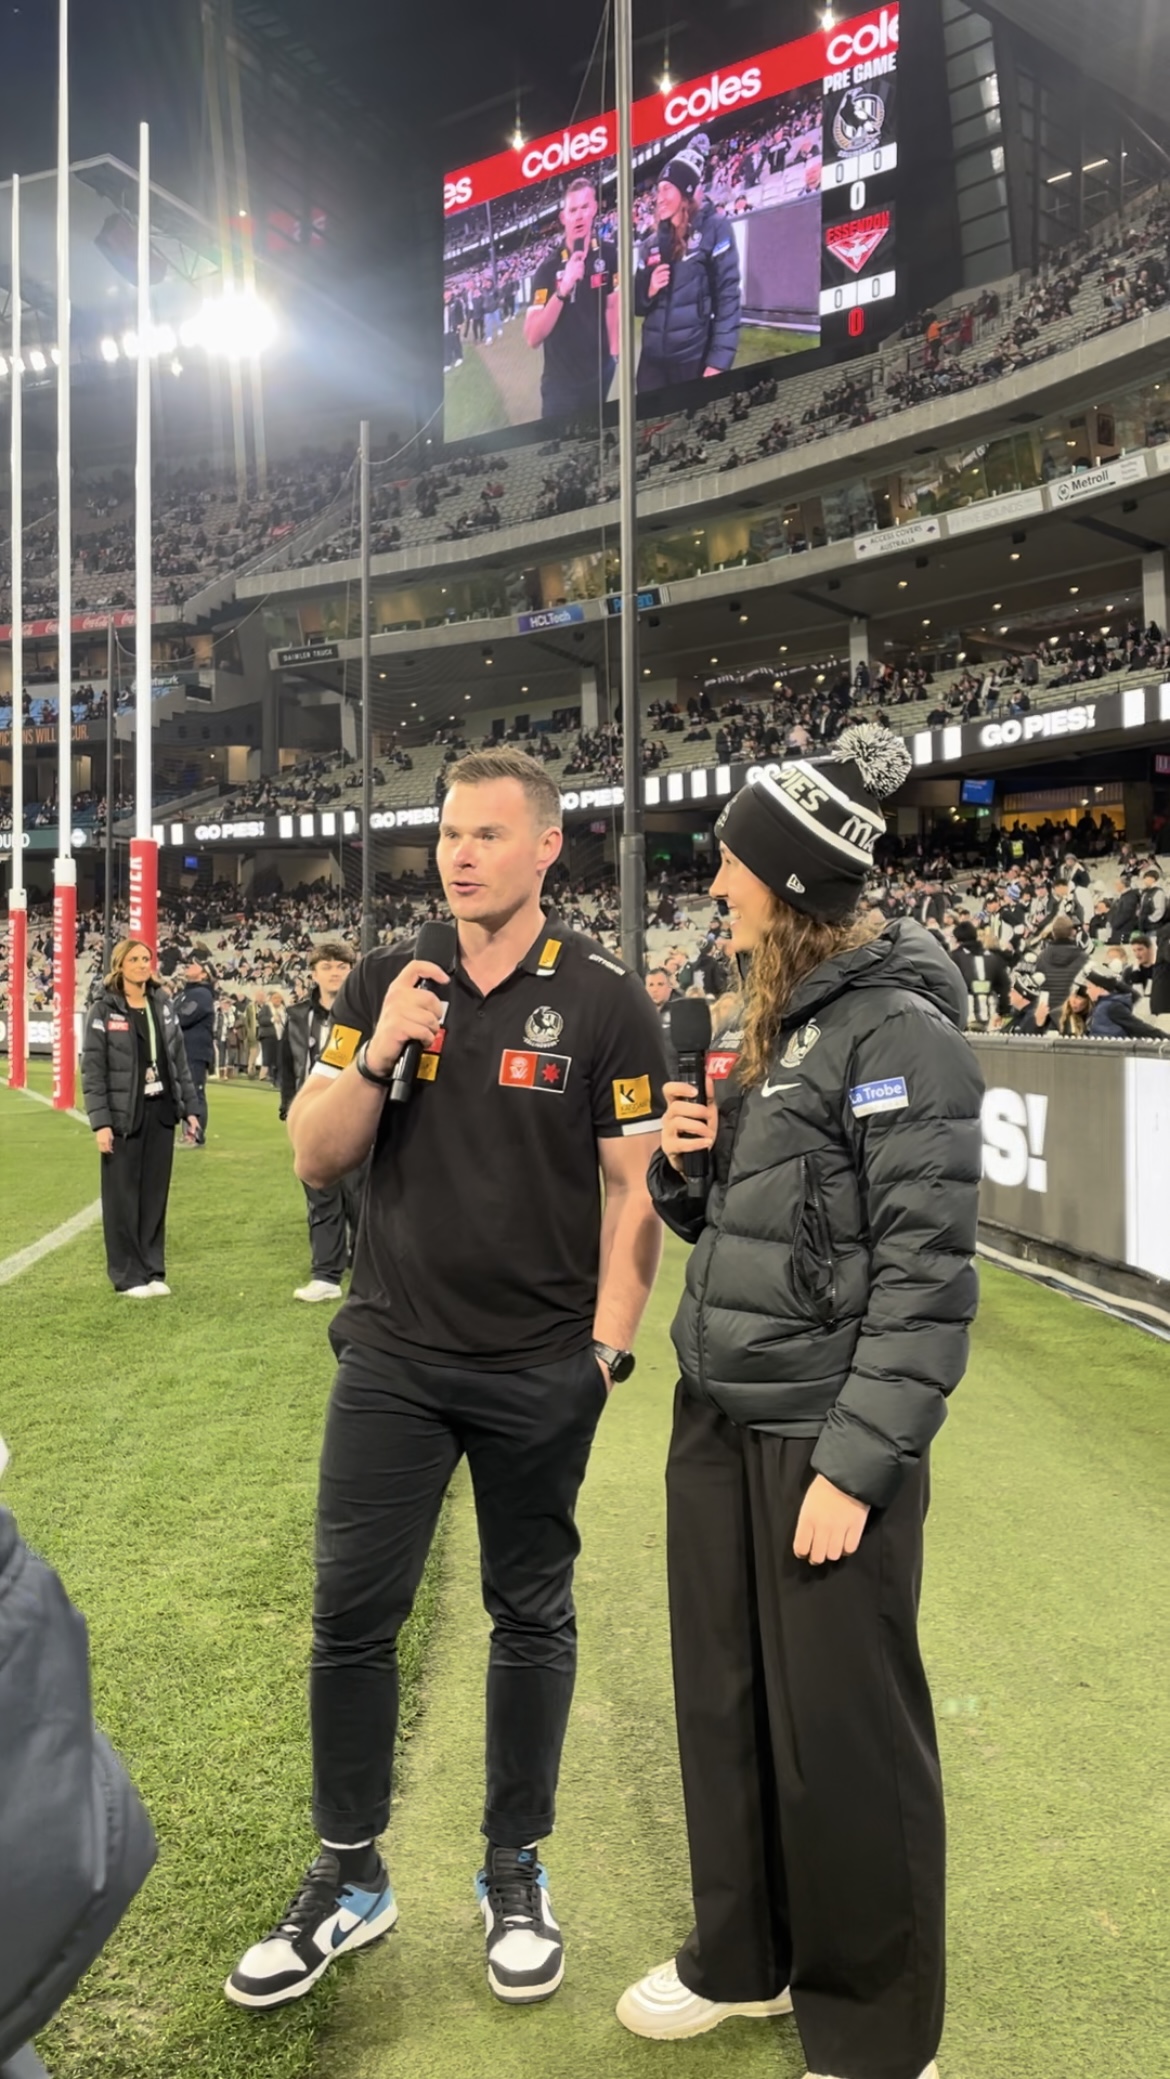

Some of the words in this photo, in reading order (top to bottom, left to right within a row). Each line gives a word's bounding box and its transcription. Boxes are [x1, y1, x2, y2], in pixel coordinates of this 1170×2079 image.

[823, 69, 851, 95] PRE
[853, 52, 897, 84] GAME
[664, 67, 762, 126] coles
[521, 125, 608, 178] coles
[835, 163, 844, 183] 0
[873, 150, 882, 171] 0
[850, 181, 866, 211] 0
[825, 210, 890, 247] ESSENDON
[834, 288, 843, 309] 0
[872, 277, 880, 298] 0
[848, 307, 864, 337] 0
[1071, 470, 1109, 491] Metroll
[529, 611, 572, 628] HCLTech
[35, 727, 57, 744] WILL
[979, 718, 1022, 747] GO
[1022, 704, 1096, 741] PIES!
[580, 786, 624, 809] PIES
[773, 767, 830, 813] PIES
[194, 823, 221, 841] GO
[221, 820, 265, 839] PIES!
[369, 811, 396, 829] GO
[396, 806, 440, 827] PIES!
[706, 1056, 735, 1075] KFC
[862, 1083, 903, 1100] Trobe
